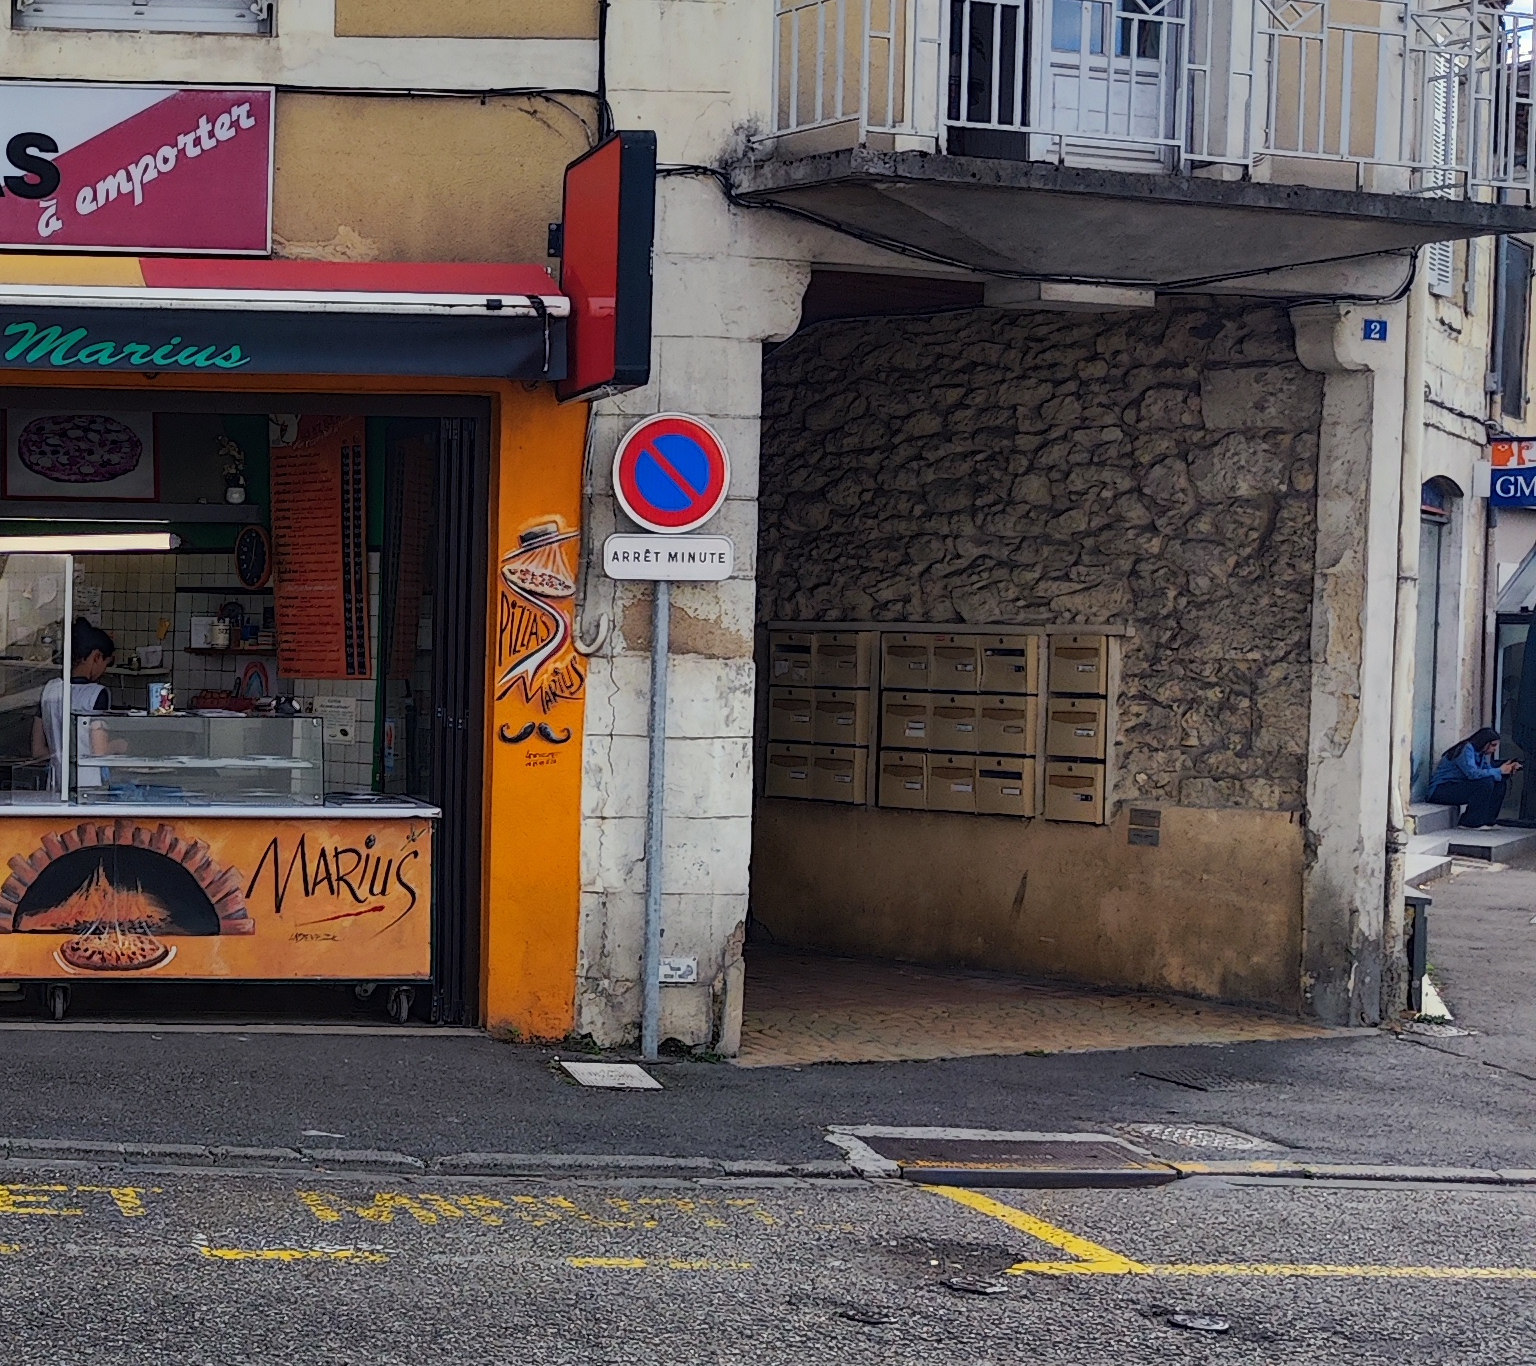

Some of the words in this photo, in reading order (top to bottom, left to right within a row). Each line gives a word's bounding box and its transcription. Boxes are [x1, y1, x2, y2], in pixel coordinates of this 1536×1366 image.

[75, 101, 256, 215] emporter
[1370, 322, 1381, 339] 2
[4, 321, 251, 369] Marius
[1495, 475, 1536, 497] GM
[612, 549, 661, 563] ARRÊT
[668, 551, 726, 564] MINUTE
